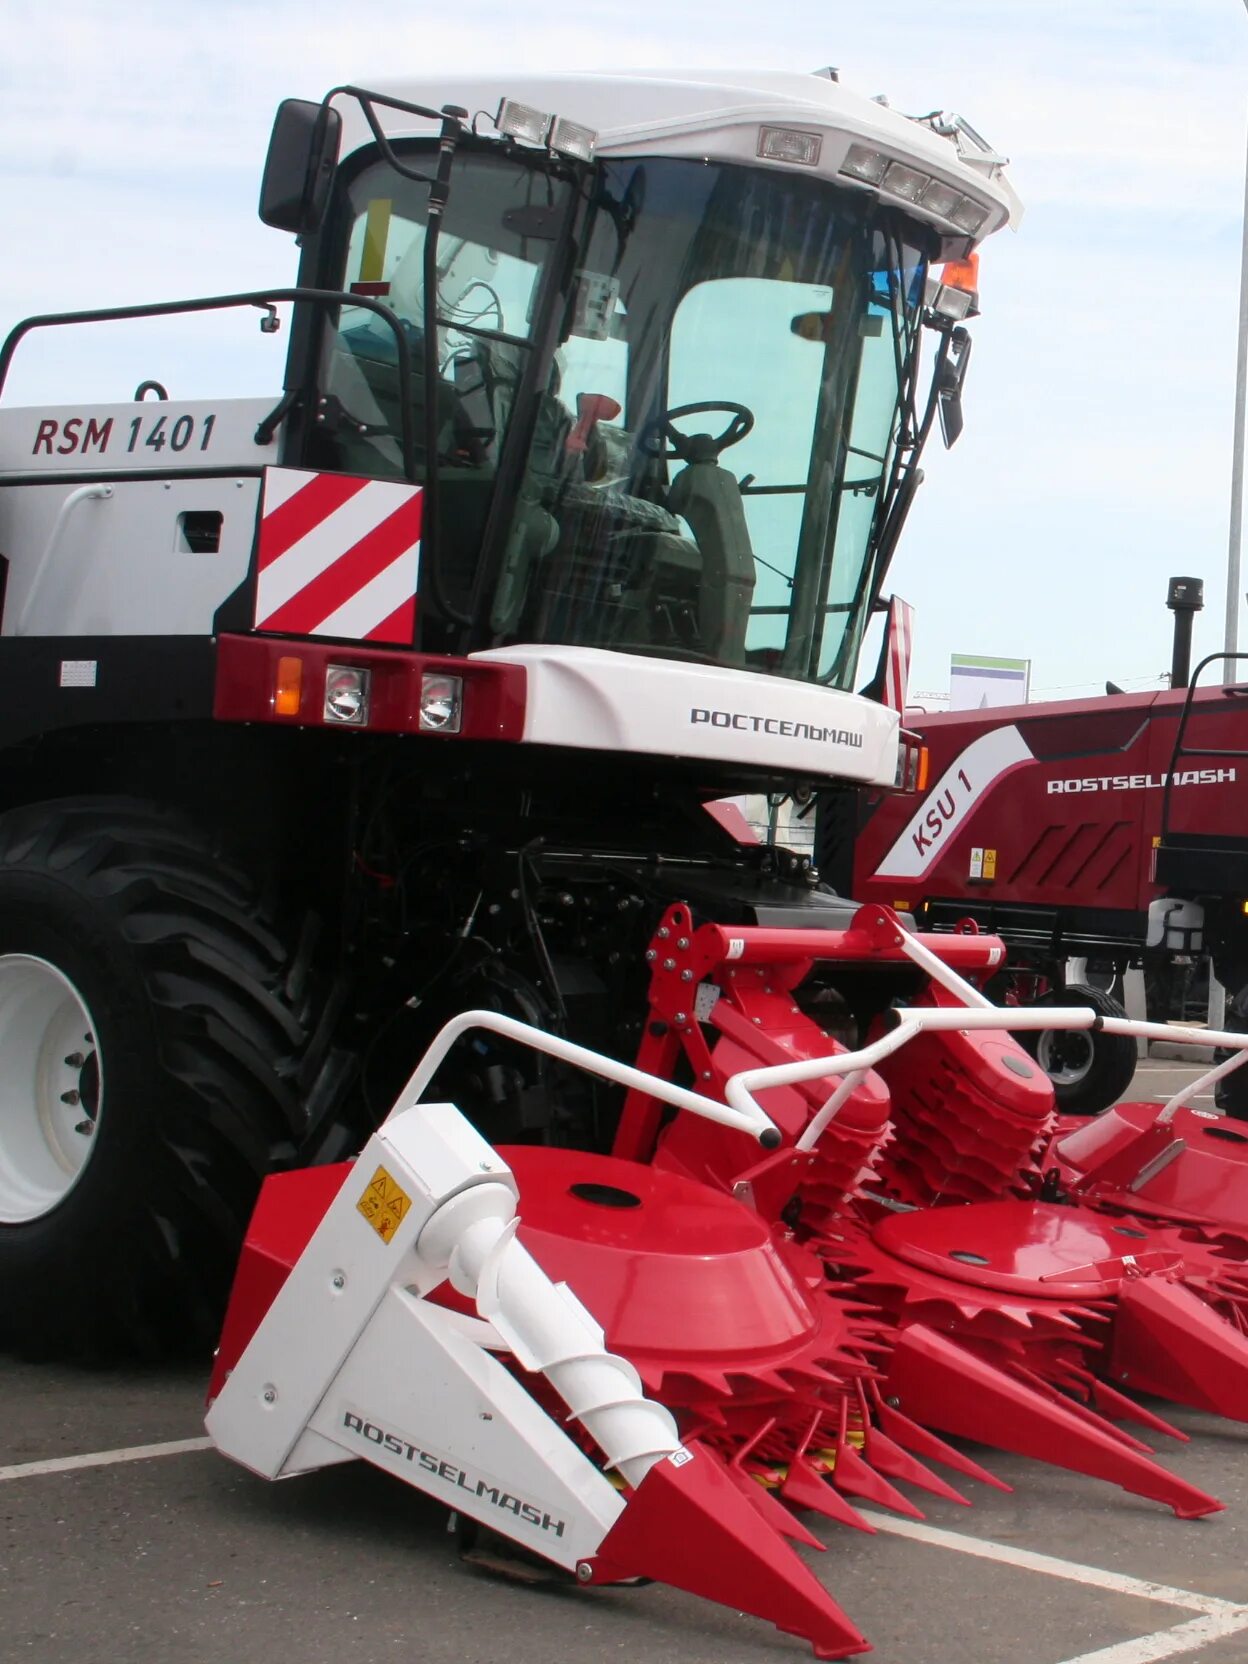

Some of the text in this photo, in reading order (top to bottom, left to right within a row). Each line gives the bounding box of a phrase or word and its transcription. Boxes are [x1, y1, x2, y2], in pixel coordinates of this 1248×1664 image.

[32, 414, 216, 455] RSM 1401
[690, 708, 864, 748] РОСТСЕЛЬМАШ
[911, 768, 974, 857] KSU 1
[343, 1411, 566, 1538] ROSTSELMASH
